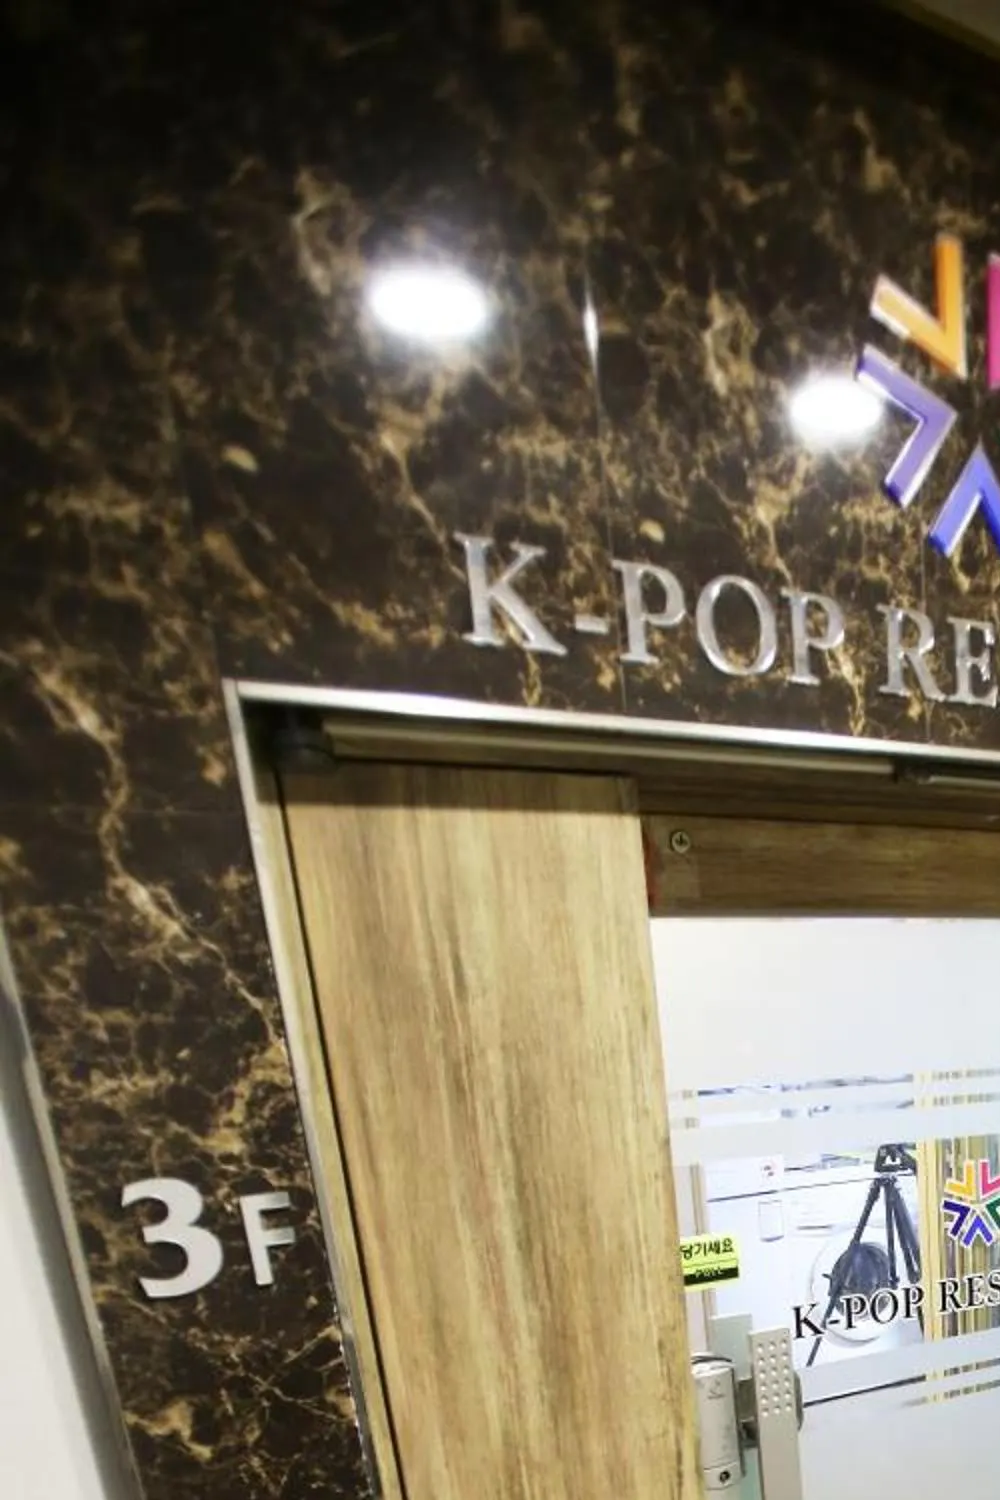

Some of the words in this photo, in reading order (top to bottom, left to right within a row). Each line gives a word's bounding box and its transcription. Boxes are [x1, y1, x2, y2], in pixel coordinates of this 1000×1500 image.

[453, 531, 845, 687] K-POP
[680, 1237, 734, 1260] 당기세요
[791, 1281, 925, 1340] K-POP
